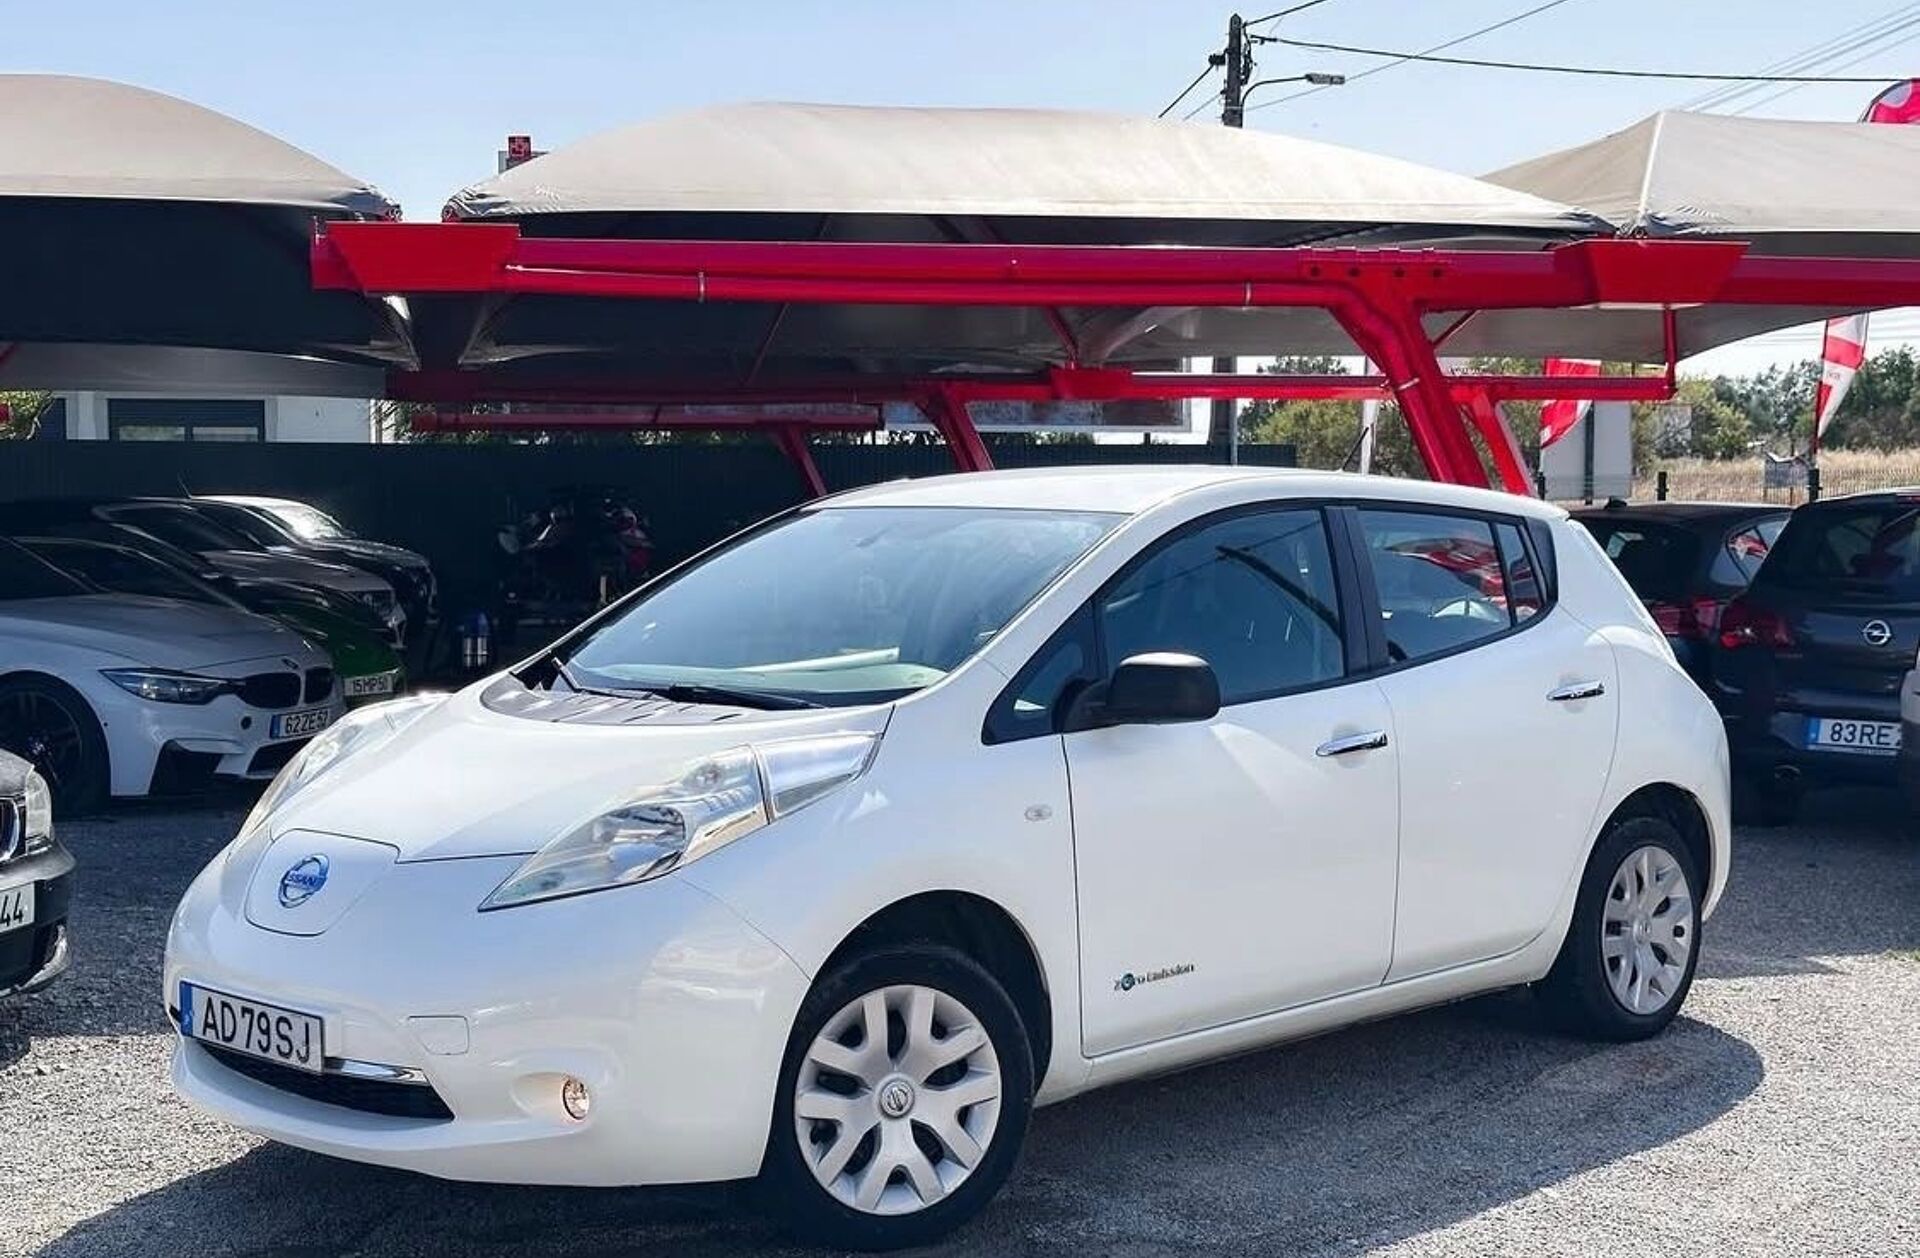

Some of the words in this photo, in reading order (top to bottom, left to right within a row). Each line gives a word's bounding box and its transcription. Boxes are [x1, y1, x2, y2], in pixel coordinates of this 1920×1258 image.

[1830, 721, 1901, 747] 83RE
[0, 891, 24, 927] 44
[202, 996, 310, 1063] AD79SJ
